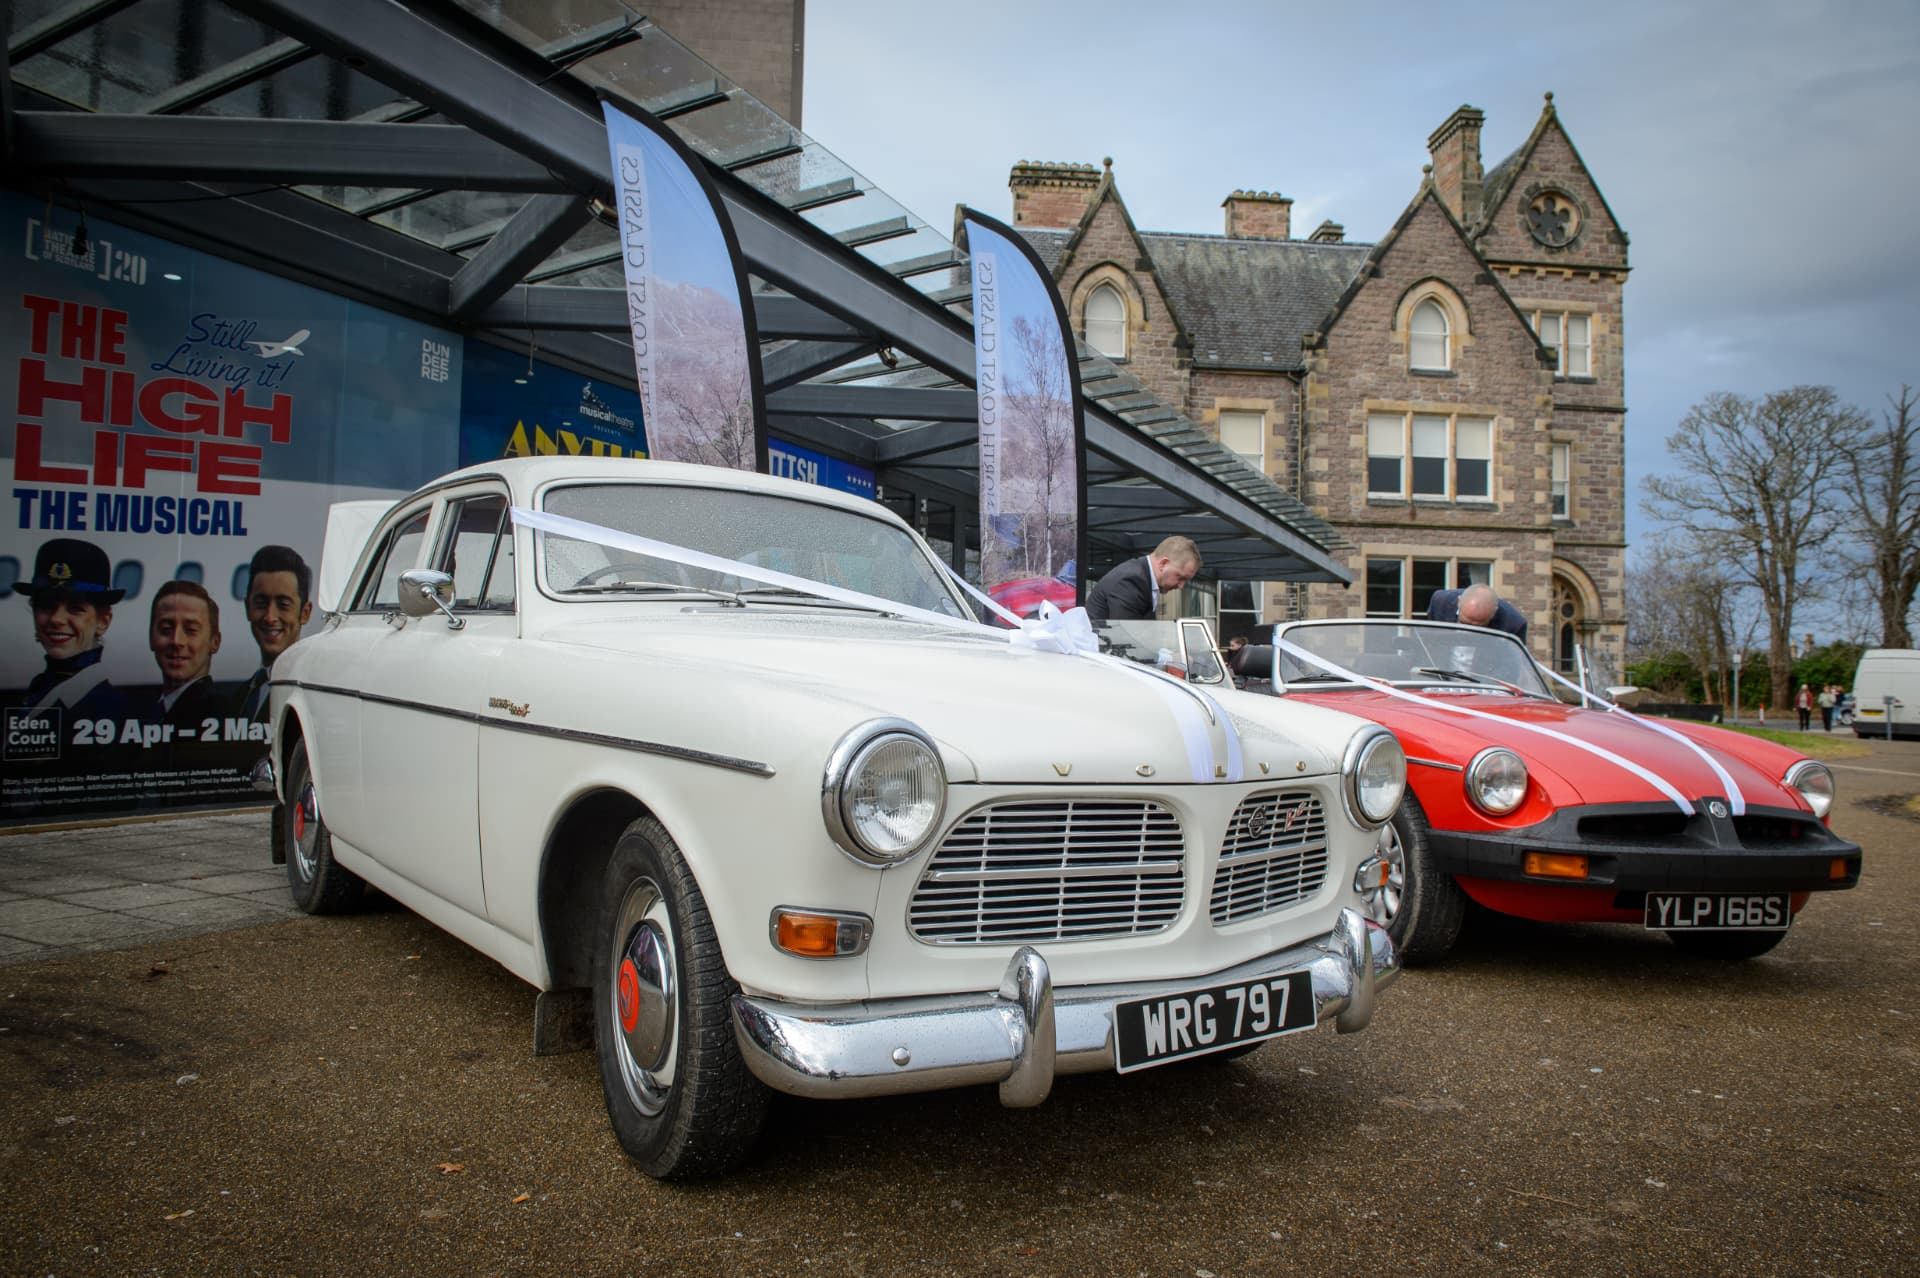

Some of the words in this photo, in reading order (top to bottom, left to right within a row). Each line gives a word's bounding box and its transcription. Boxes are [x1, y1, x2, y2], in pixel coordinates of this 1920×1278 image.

[114, 249, 147, 286] 20
[23, 294, 128, 366] THE
[185, 313, 256, 353] Still
[422, 339, 450, 358] DUN
[422, 352, 449, 372] DEE
[151, 344, 250, 394] Living
[256, 359, 294, 391] it!
[421, 365, 448, 384] REP
[17, 358, 292, 444] HIGH
[14, 423, 263, 496] LIFE
[13, 488, 87, 531] THE
[95, 492, 247, 536] MUSICAL
[8, 730, 57, 745] Court
[9, 715, 50, 730] Eden
[72, 718, 116, 745] 29
[120, 718, 174, 748] Apr
[200, 718, 219, 742] 2
[1052, 760, 1306, 778] VOLVO
[1655, 896, 1712, 927] YLP
[1719, 896, 1782, 927] 166S
[1142, 994, 1216, 1057] WRG
[1232, 979, 1291, 1040] 797
